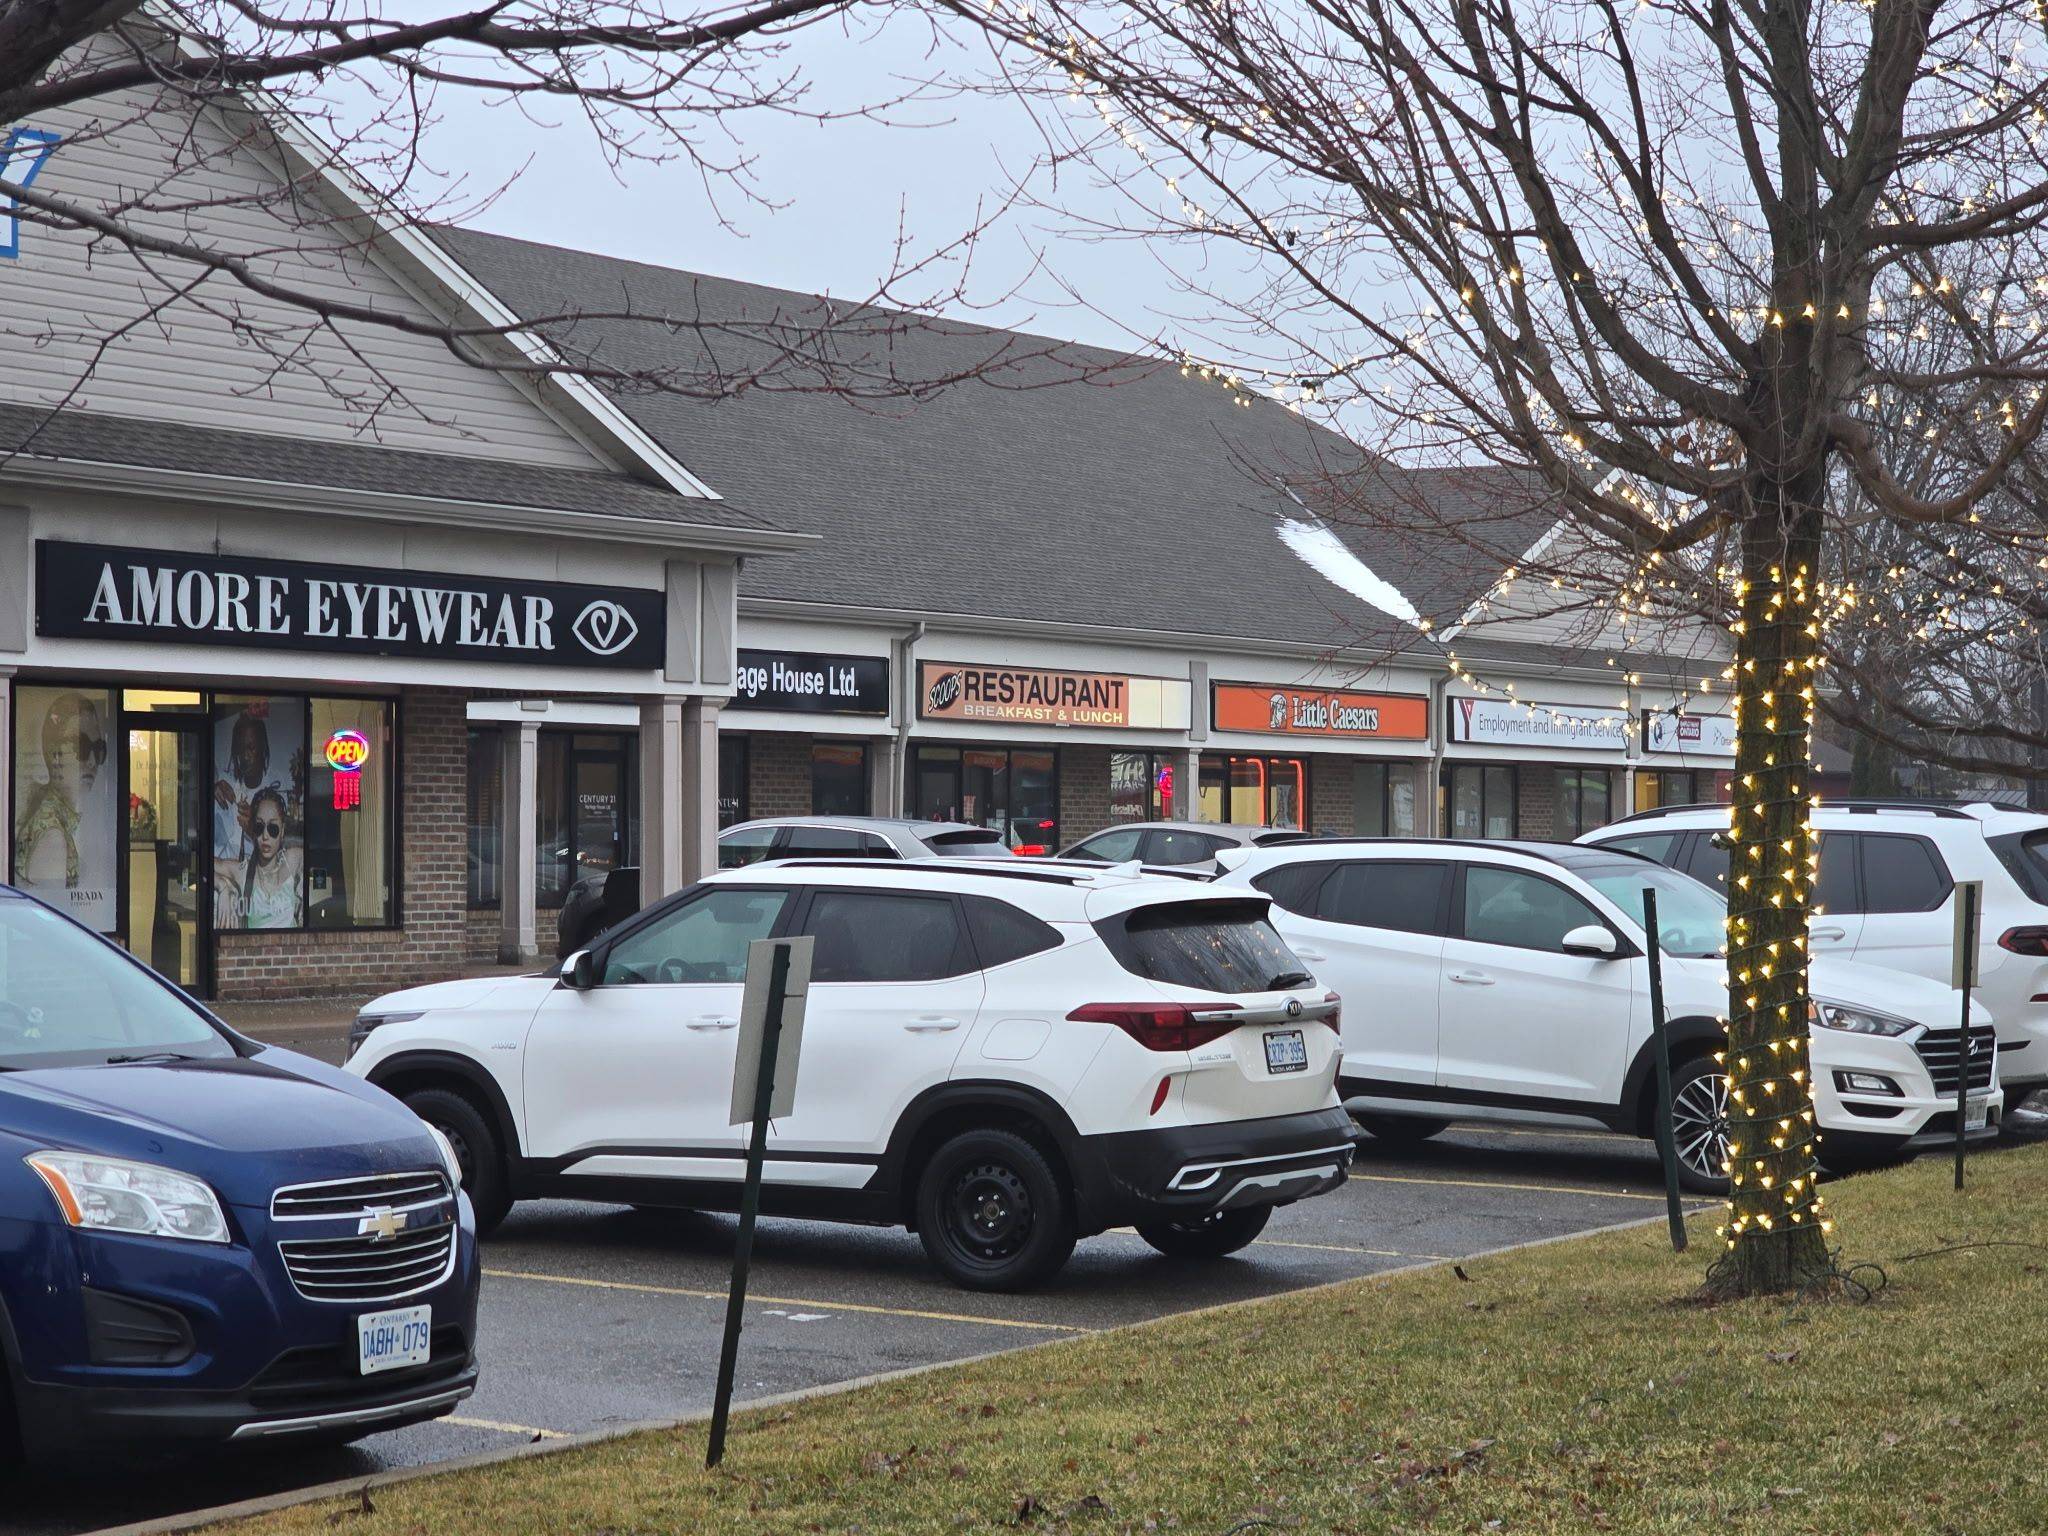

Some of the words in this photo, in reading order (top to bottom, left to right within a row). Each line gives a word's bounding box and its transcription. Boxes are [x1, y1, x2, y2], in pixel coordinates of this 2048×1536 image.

[83, 562, 291, 632] AMORE
[303, 579, 555, 650] EYEWEAR
[772, 661, 824, 694] House
[830, 666, 859, 697] Ltd.
[964, 670, 1124, 709] RESTAURANT
[928, 670, 963, 713] SCOOPS
[964, 704, 1052, 721] BREAKFAST
[1058, 709, 1068, 721] &
[1073, 710, 1123, 724] LUNCH
[1292, 697, 1327, 728] Little
[1330, 699, 1378, 730] Caesars
[1479, 713, 1536, 737] Employment
[1537, 716, 1549, 735] and
[1550, 718, 1592, 740] Immigrant
[327, 741, 364, 762] OPEN
[579, 794, 609, 804] CENTURY
[70, 891, 104, 902] PRADA
[1289, 1041, 1304, 1062] 395
[380, 1312, 412, 1326] ONTARIO
